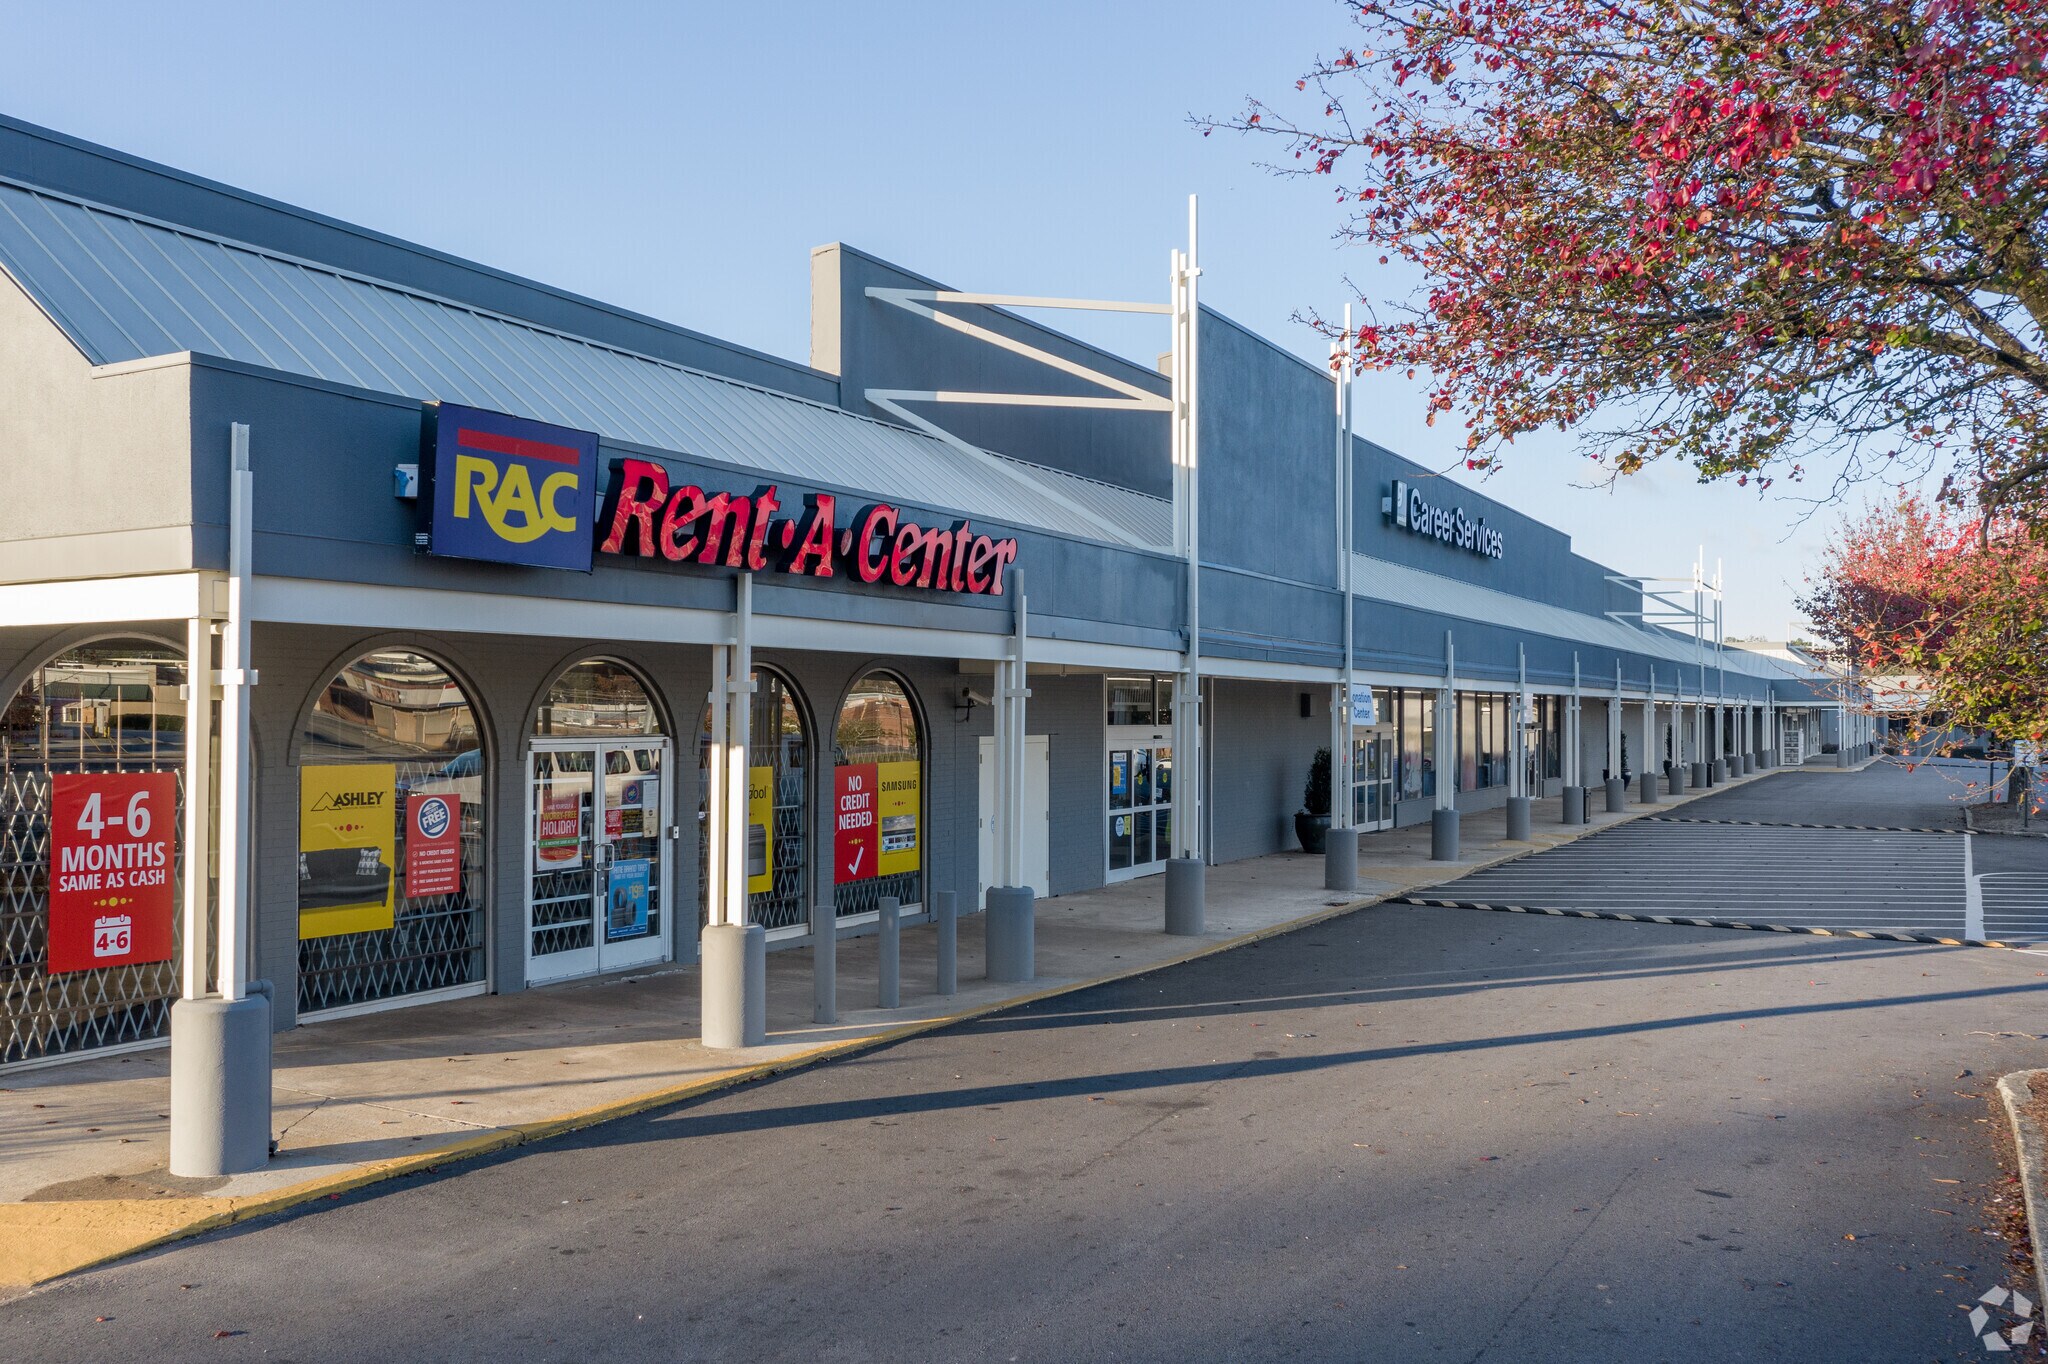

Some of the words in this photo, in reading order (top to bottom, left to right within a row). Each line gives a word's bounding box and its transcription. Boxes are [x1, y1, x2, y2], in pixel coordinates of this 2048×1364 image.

[454, 454, 579, 543] RAC
[1411, 488, 1455, 542] Career
[1456, 507, 1503, 560] Services
[1352, 692, 1371, 703] onation
[1354, 706, 1370, 718] Center
[848, 775, 862, 792] NO
[882, 780, 917, 792] SAMSUNG
[333, 791, 384, 807] ASHLEY
[840, 793, 870, 811] CREDIT
[77, 790, 151, 840] 4-6
[422, 808, 447, 828] FREE
[839, 811, 872, 830] NEEDED
[542, 820, 577, 836] HOLIDAY
[61, 842, 166, 873] MONTHS
[59, 873, 101, 892] SAME
[106, 872, 125, 889] AS
[129, 869, 165, 887] CASH
[96, 931, 128, 950] 4-6
